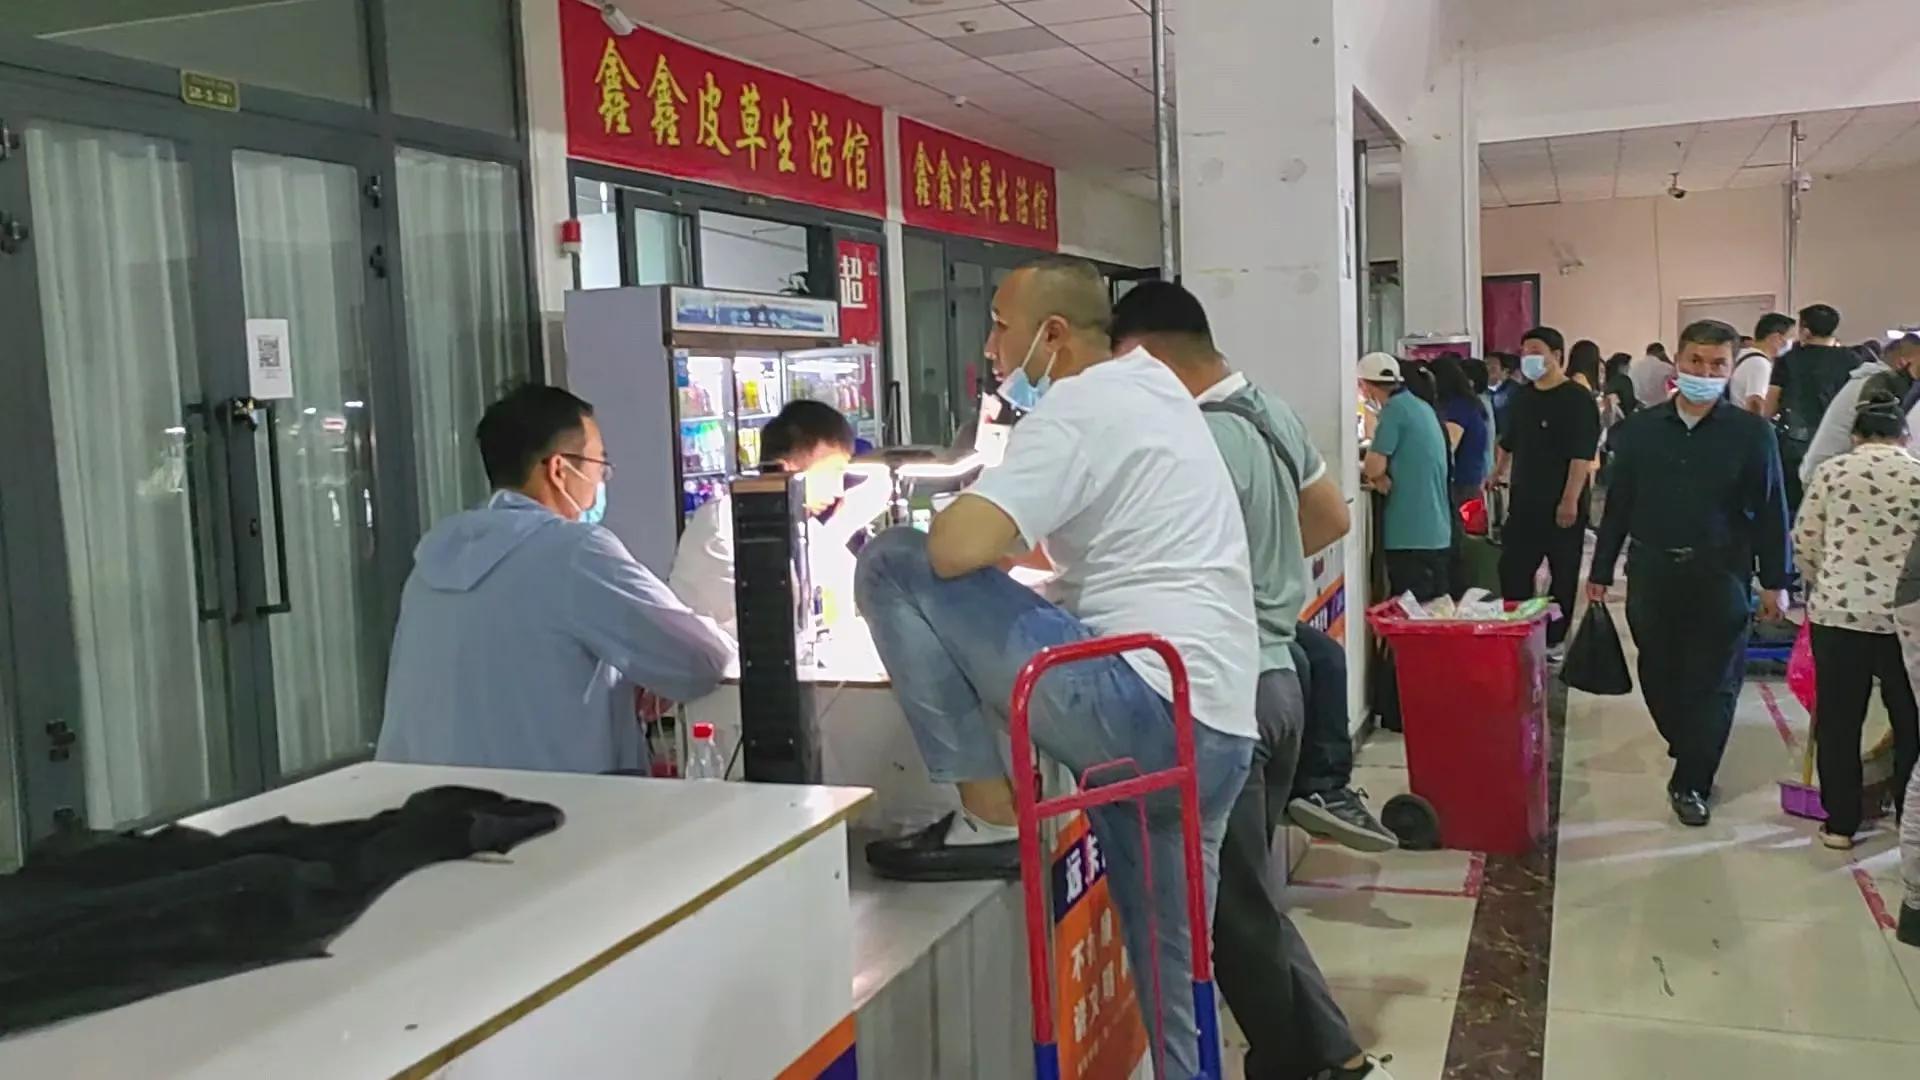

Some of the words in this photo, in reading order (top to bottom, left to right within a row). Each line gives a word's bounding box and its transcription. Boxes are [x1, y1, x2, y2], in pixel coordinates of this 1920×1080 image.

[595, 37, 870, 190] 鑫鑫皮草生活馆
[914, 140, 1049, 230] 鑫鑫皮草生活馆
